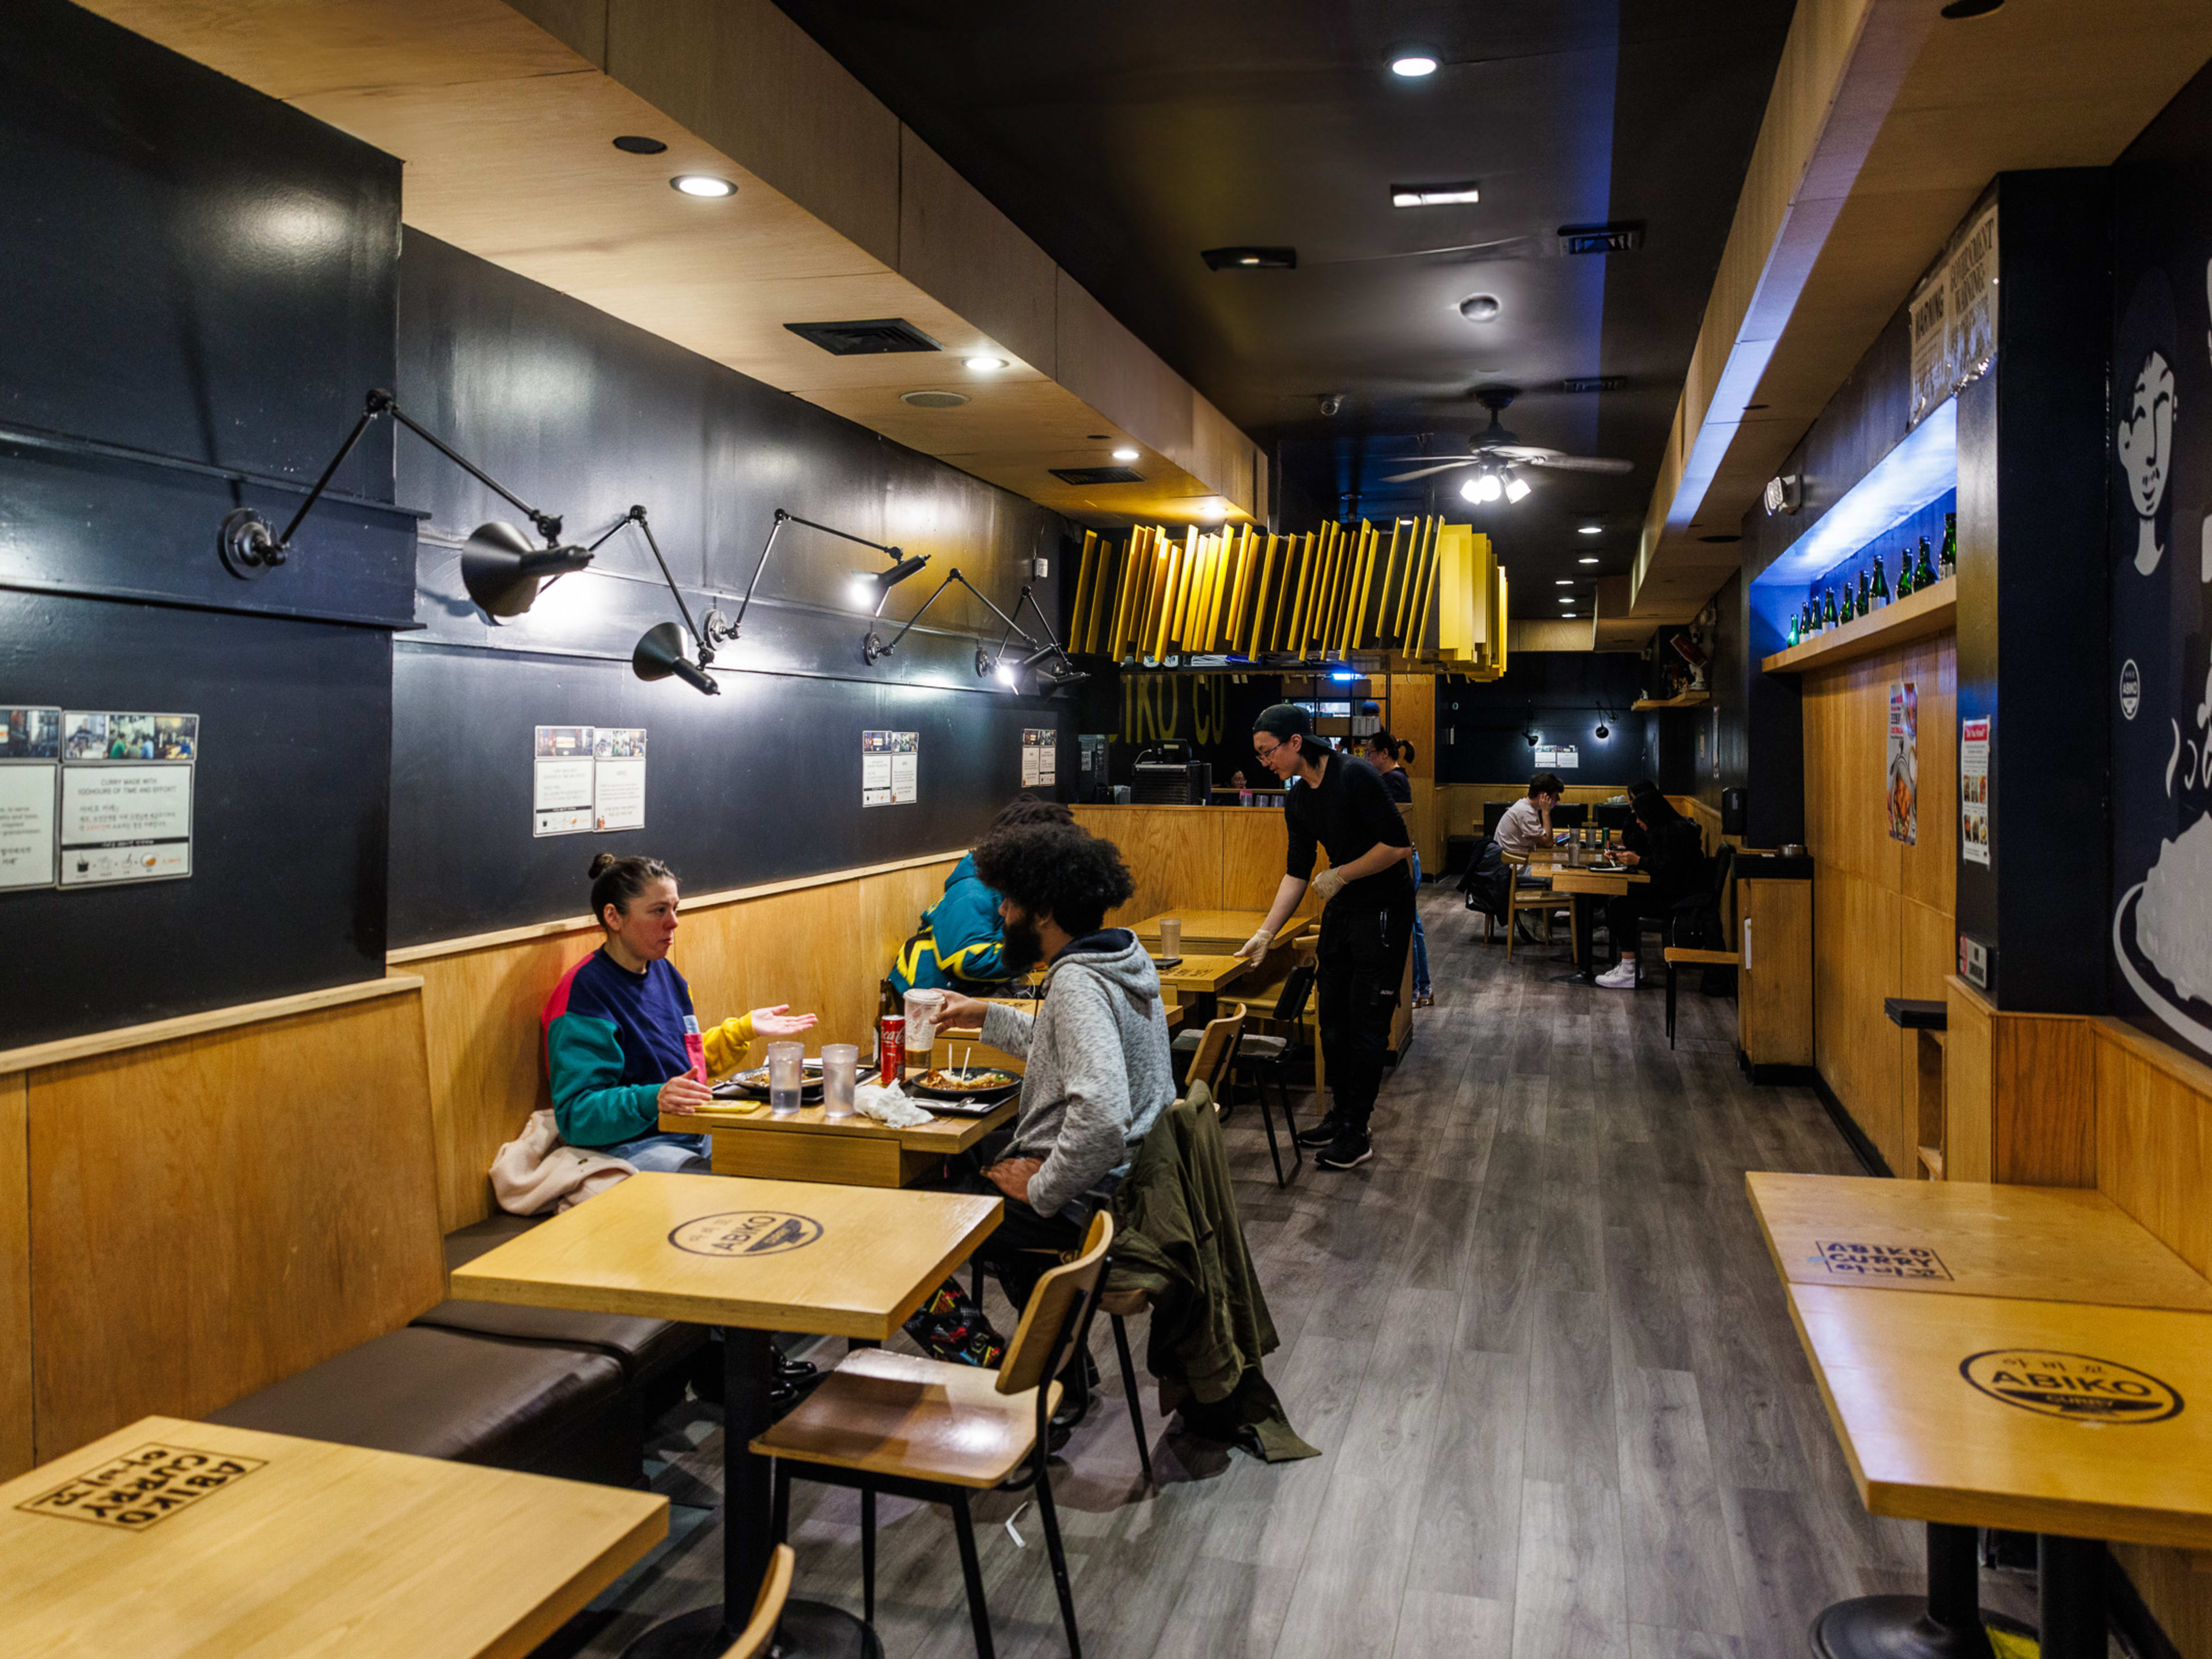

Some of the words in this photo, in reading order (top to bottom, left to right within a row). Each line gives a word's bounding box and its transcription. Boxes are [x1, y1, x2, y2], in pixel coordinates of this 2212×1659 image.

[1109, 675, 1177, 744] IKO
[710, 1215, 777, 1252] ABIKO
[1828, 1242, 1930, 1257] ABIKO
[1829, 1253, 1933, 1267] CURRY
[1992, 1370, 2152, 1397] ABIKO
[81, 1453, 209, 1518] CURRY
[115, 1460, 247, 1525] ABIKO
